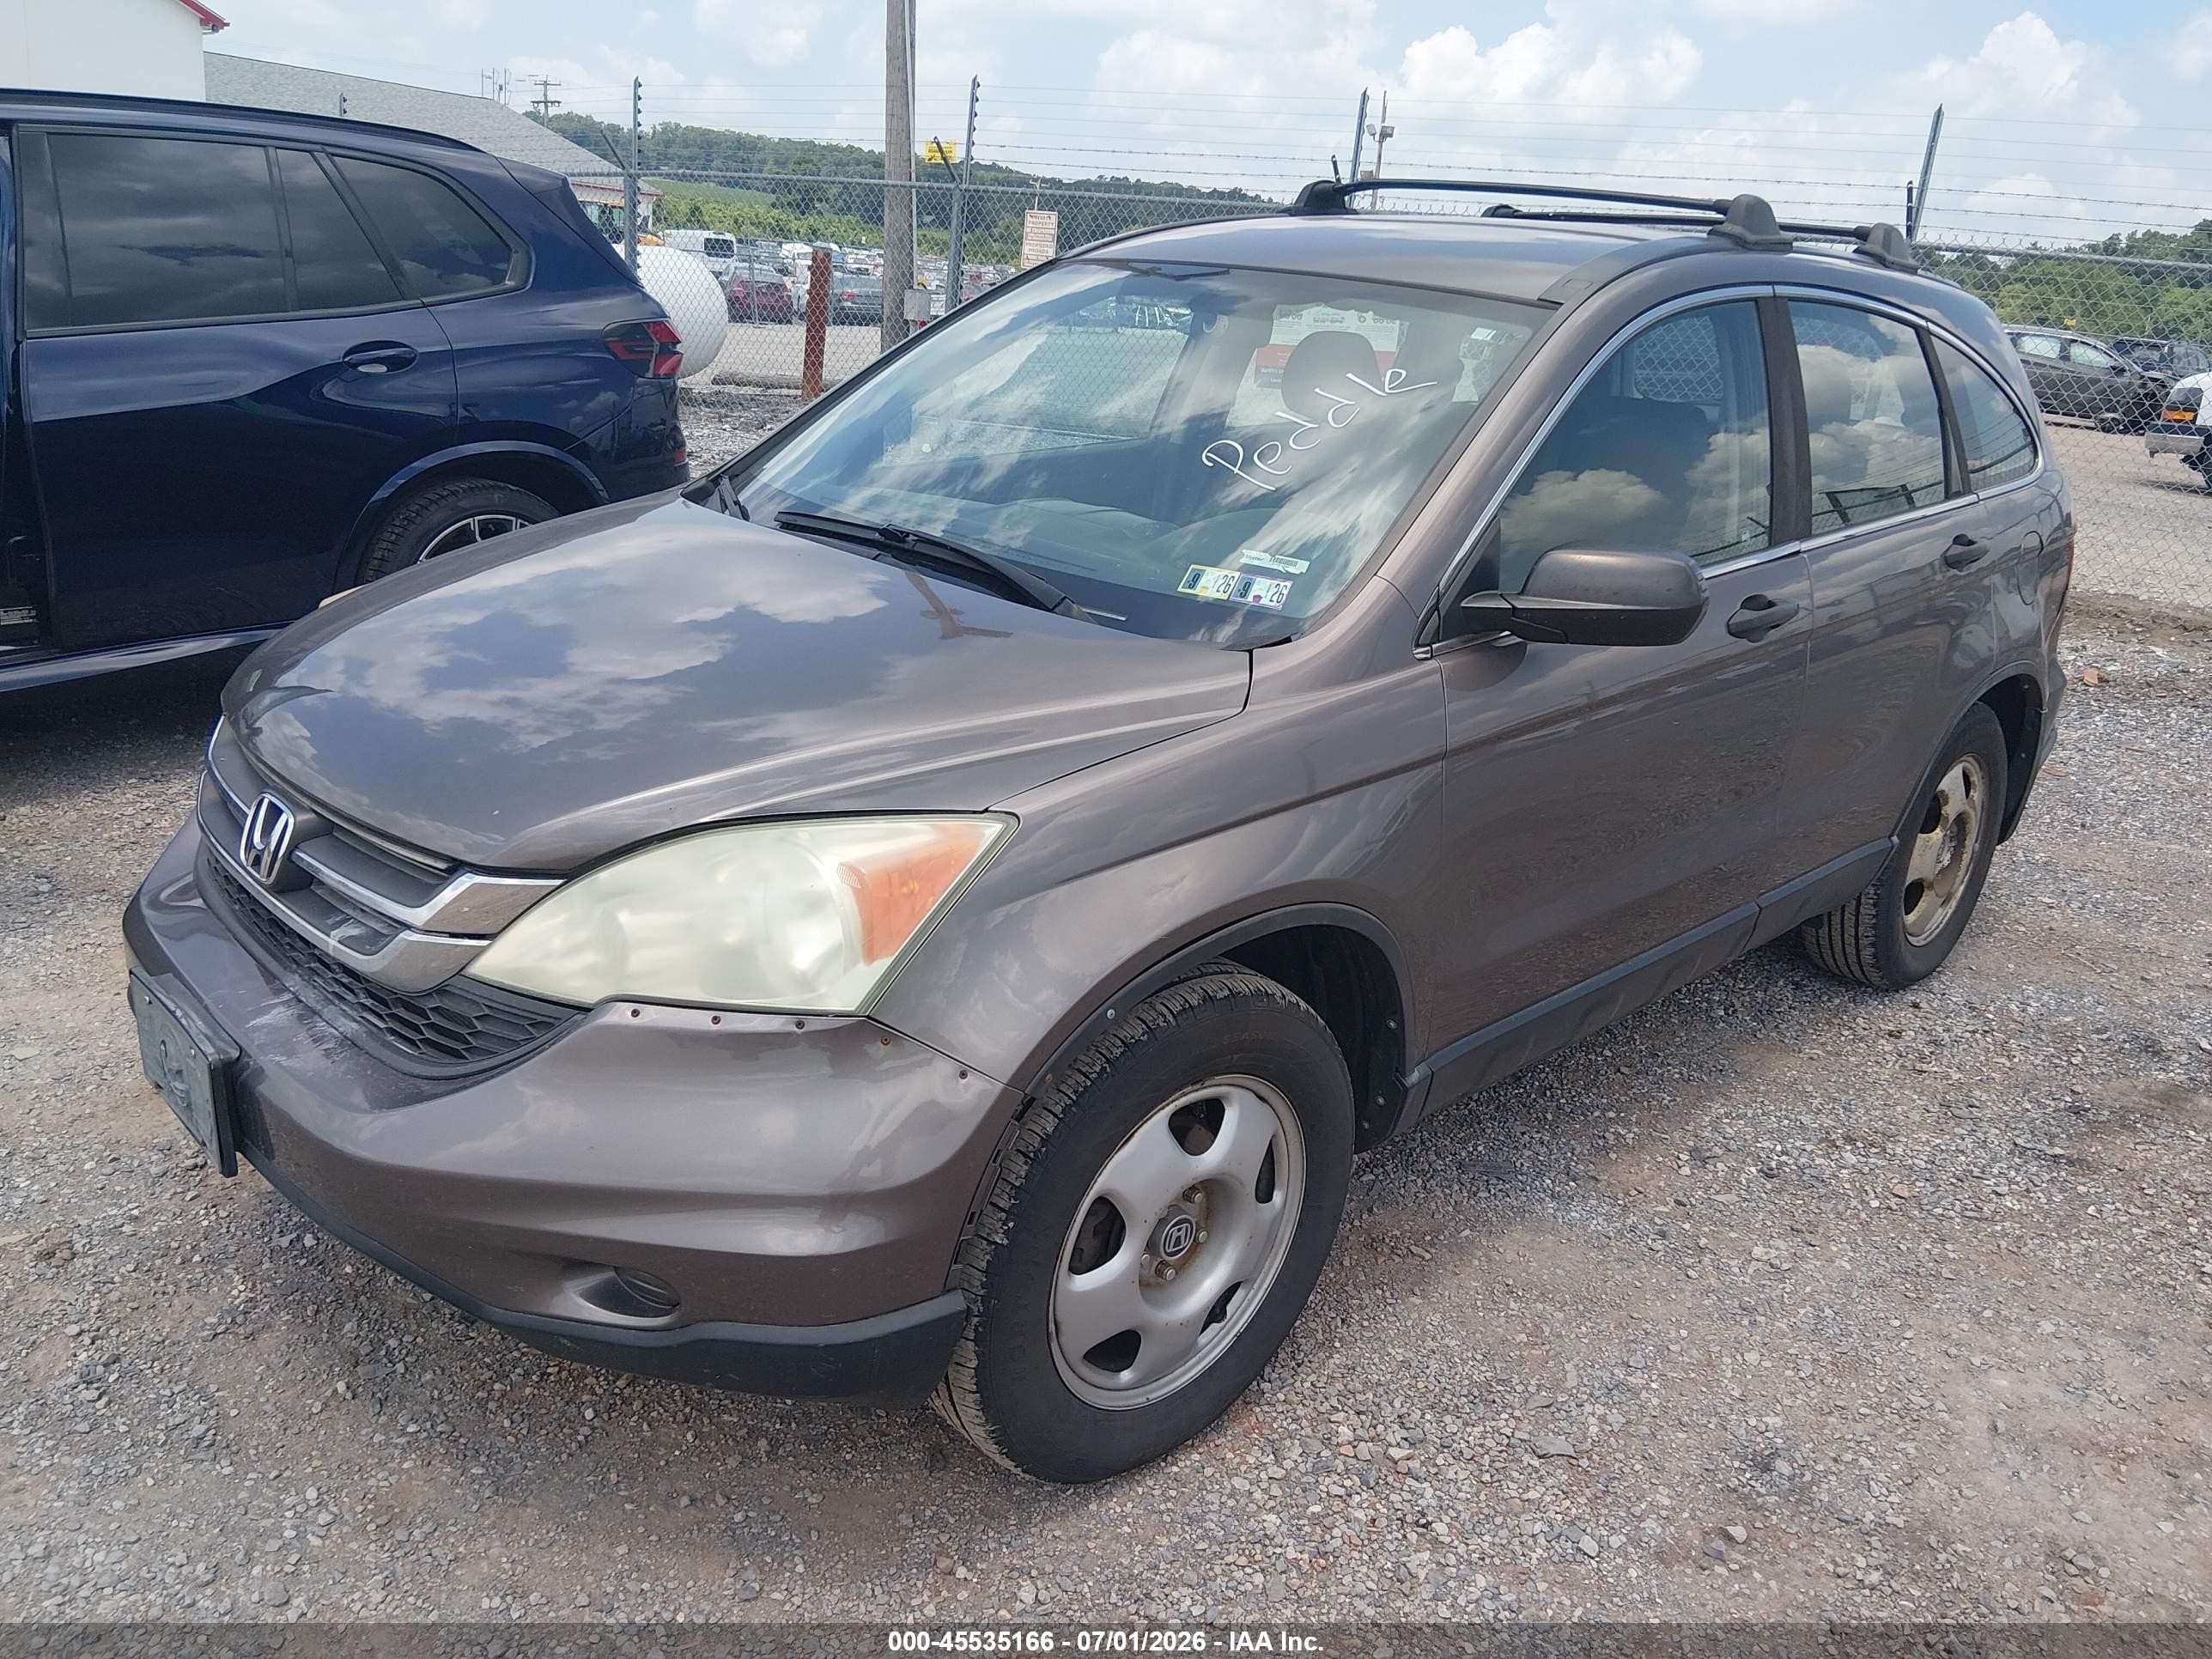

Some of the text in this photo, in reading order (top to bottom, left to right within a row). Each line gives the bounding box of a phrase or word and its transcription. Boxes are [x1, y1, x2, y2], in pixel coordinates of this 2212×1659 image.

[1202, 368, 1437, 491] Peddle
[1216, 574, 1236, 593] 26
[1269, 583, 1288, 604] 26
